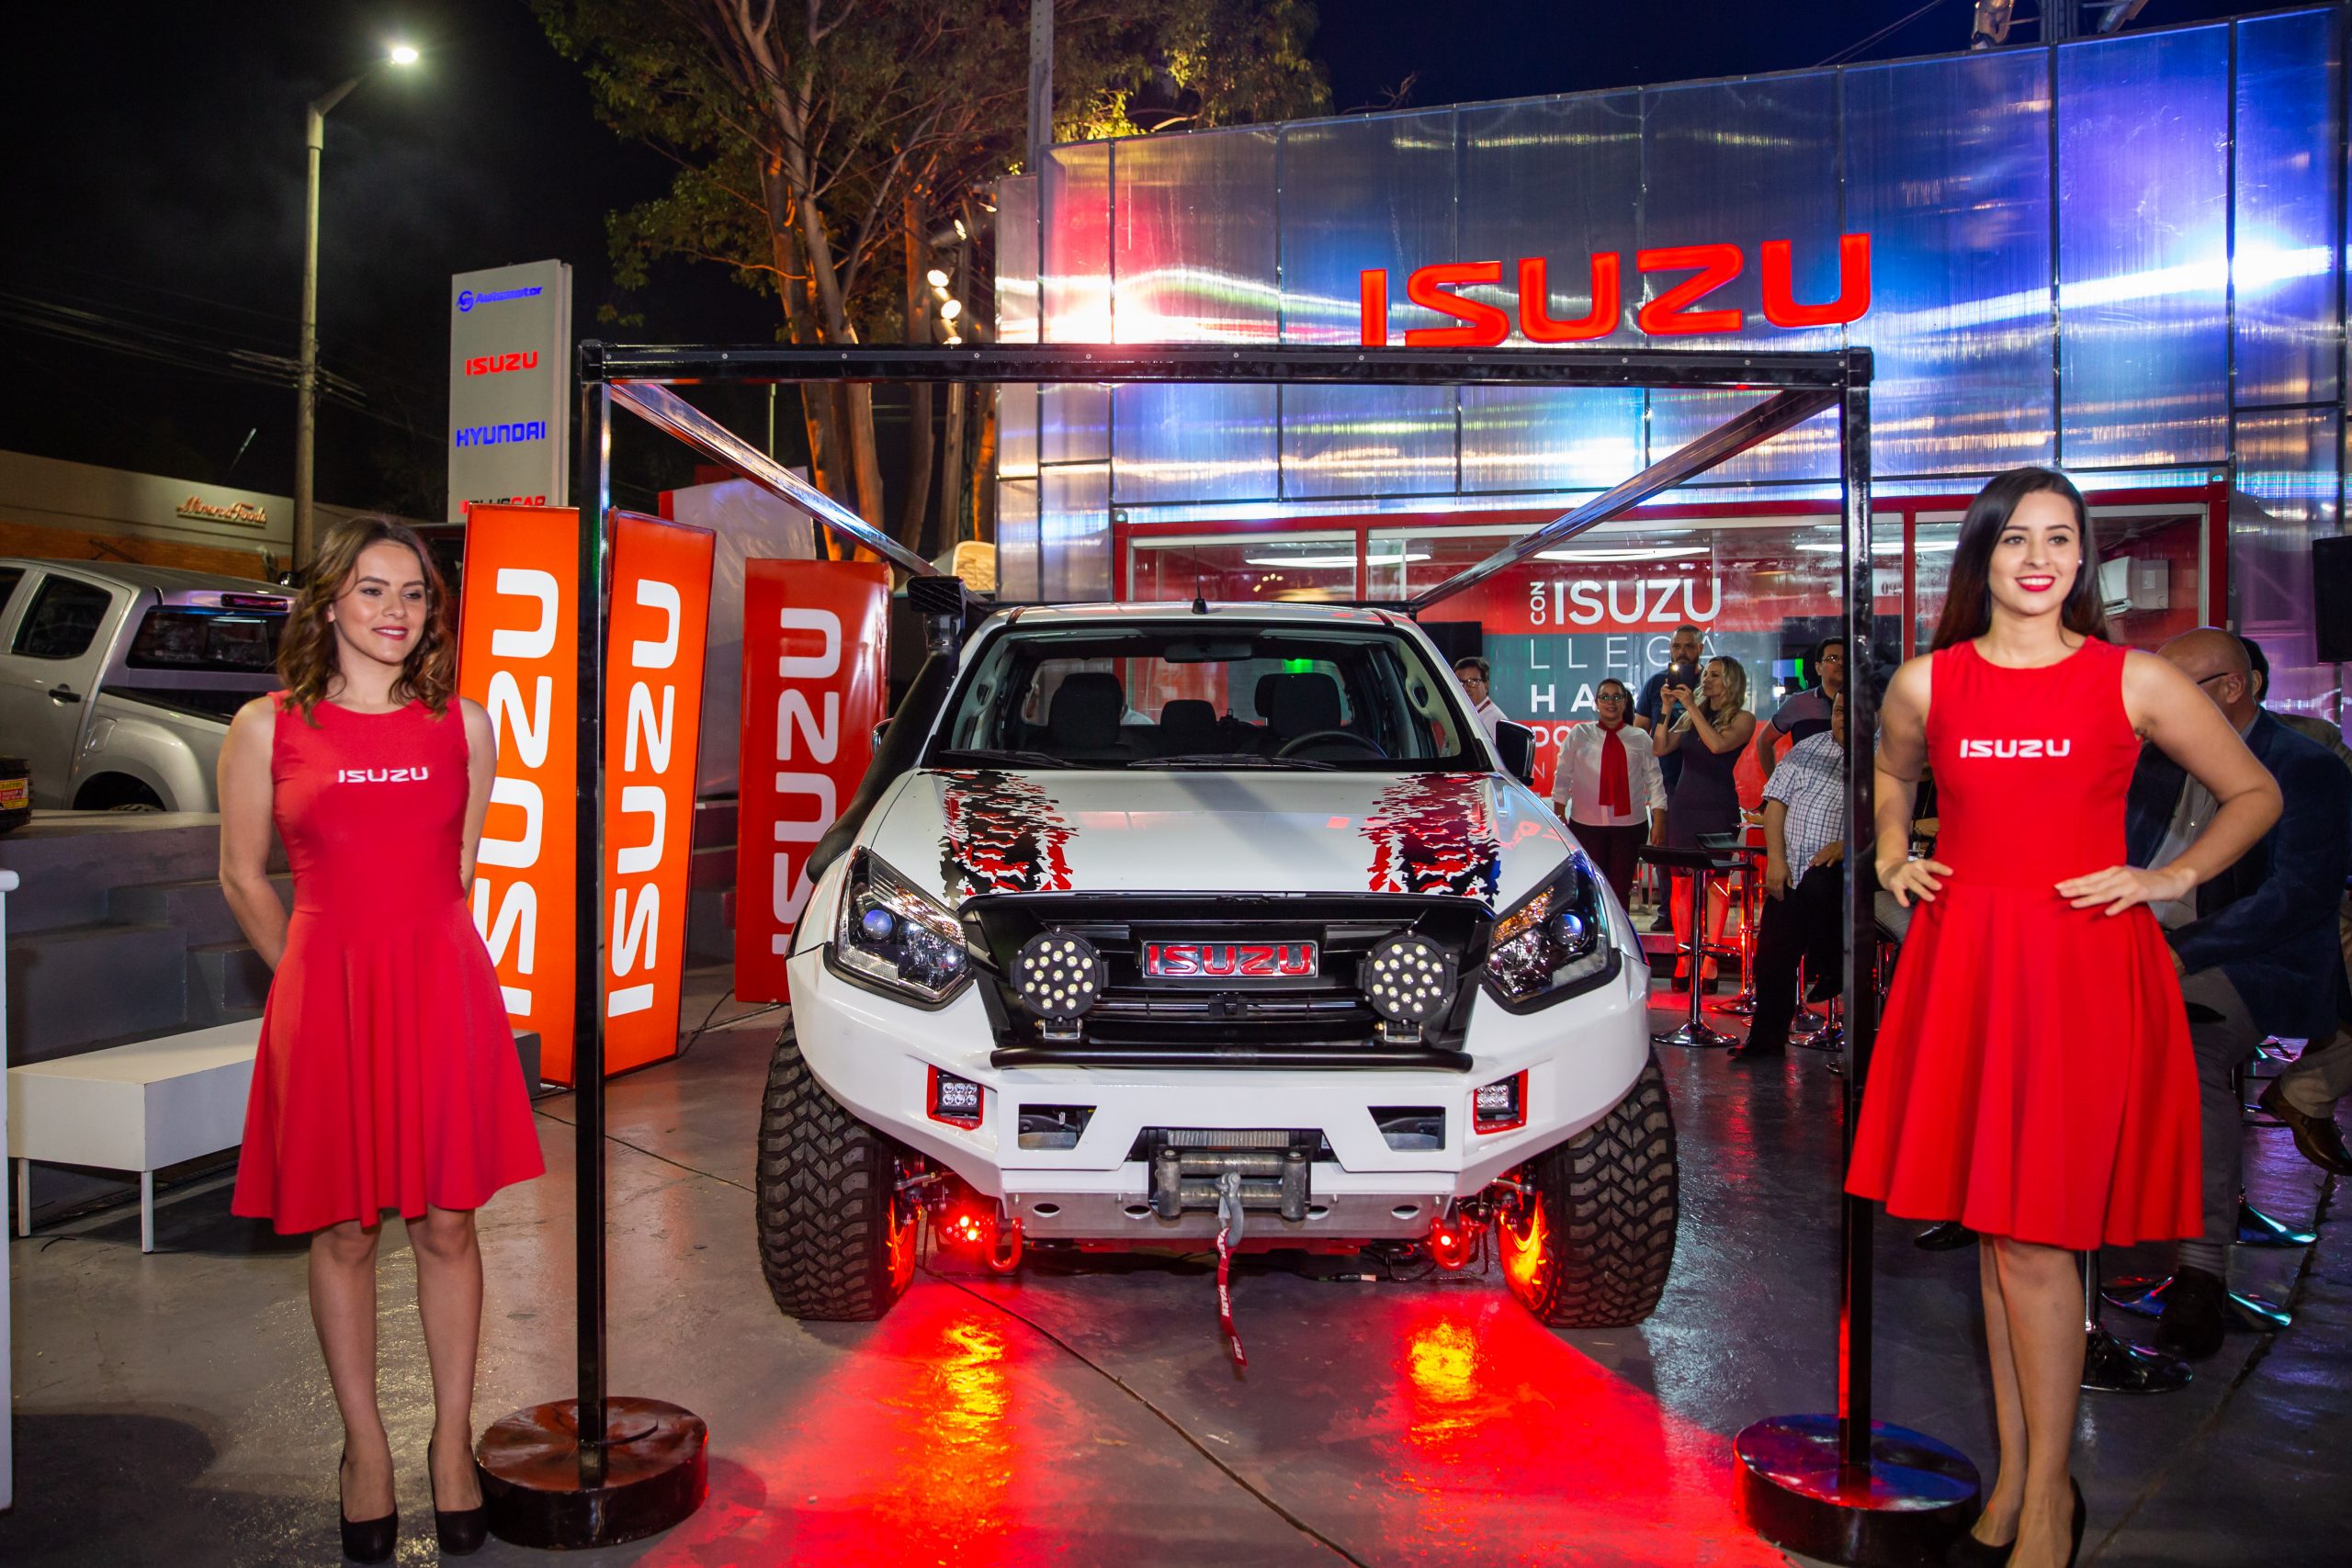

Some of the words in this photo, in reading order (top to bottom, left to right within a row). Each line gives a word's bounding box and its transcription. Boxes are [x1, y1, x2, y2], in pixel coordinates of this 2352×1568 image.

[1360, 232, 1871, 347] ISUZU
[466, 351, 538, 377] ISUZU
[456, 421, 547, 447] HYUNDAI
[1530, 581, 1546, 626] CON
[1555, 578, 1722, 626] ISUZU
[1959, 739, 2071, 759] ISUZU
[337, 766, 429, 784] ISUZU
[772, 607, 842, 955] SUZU
[607, 579, 681, 1019] ISUZU
[1148, 944, 1312, 976] ISUZU
[1218, 1284, 1230, 1317] WARN
